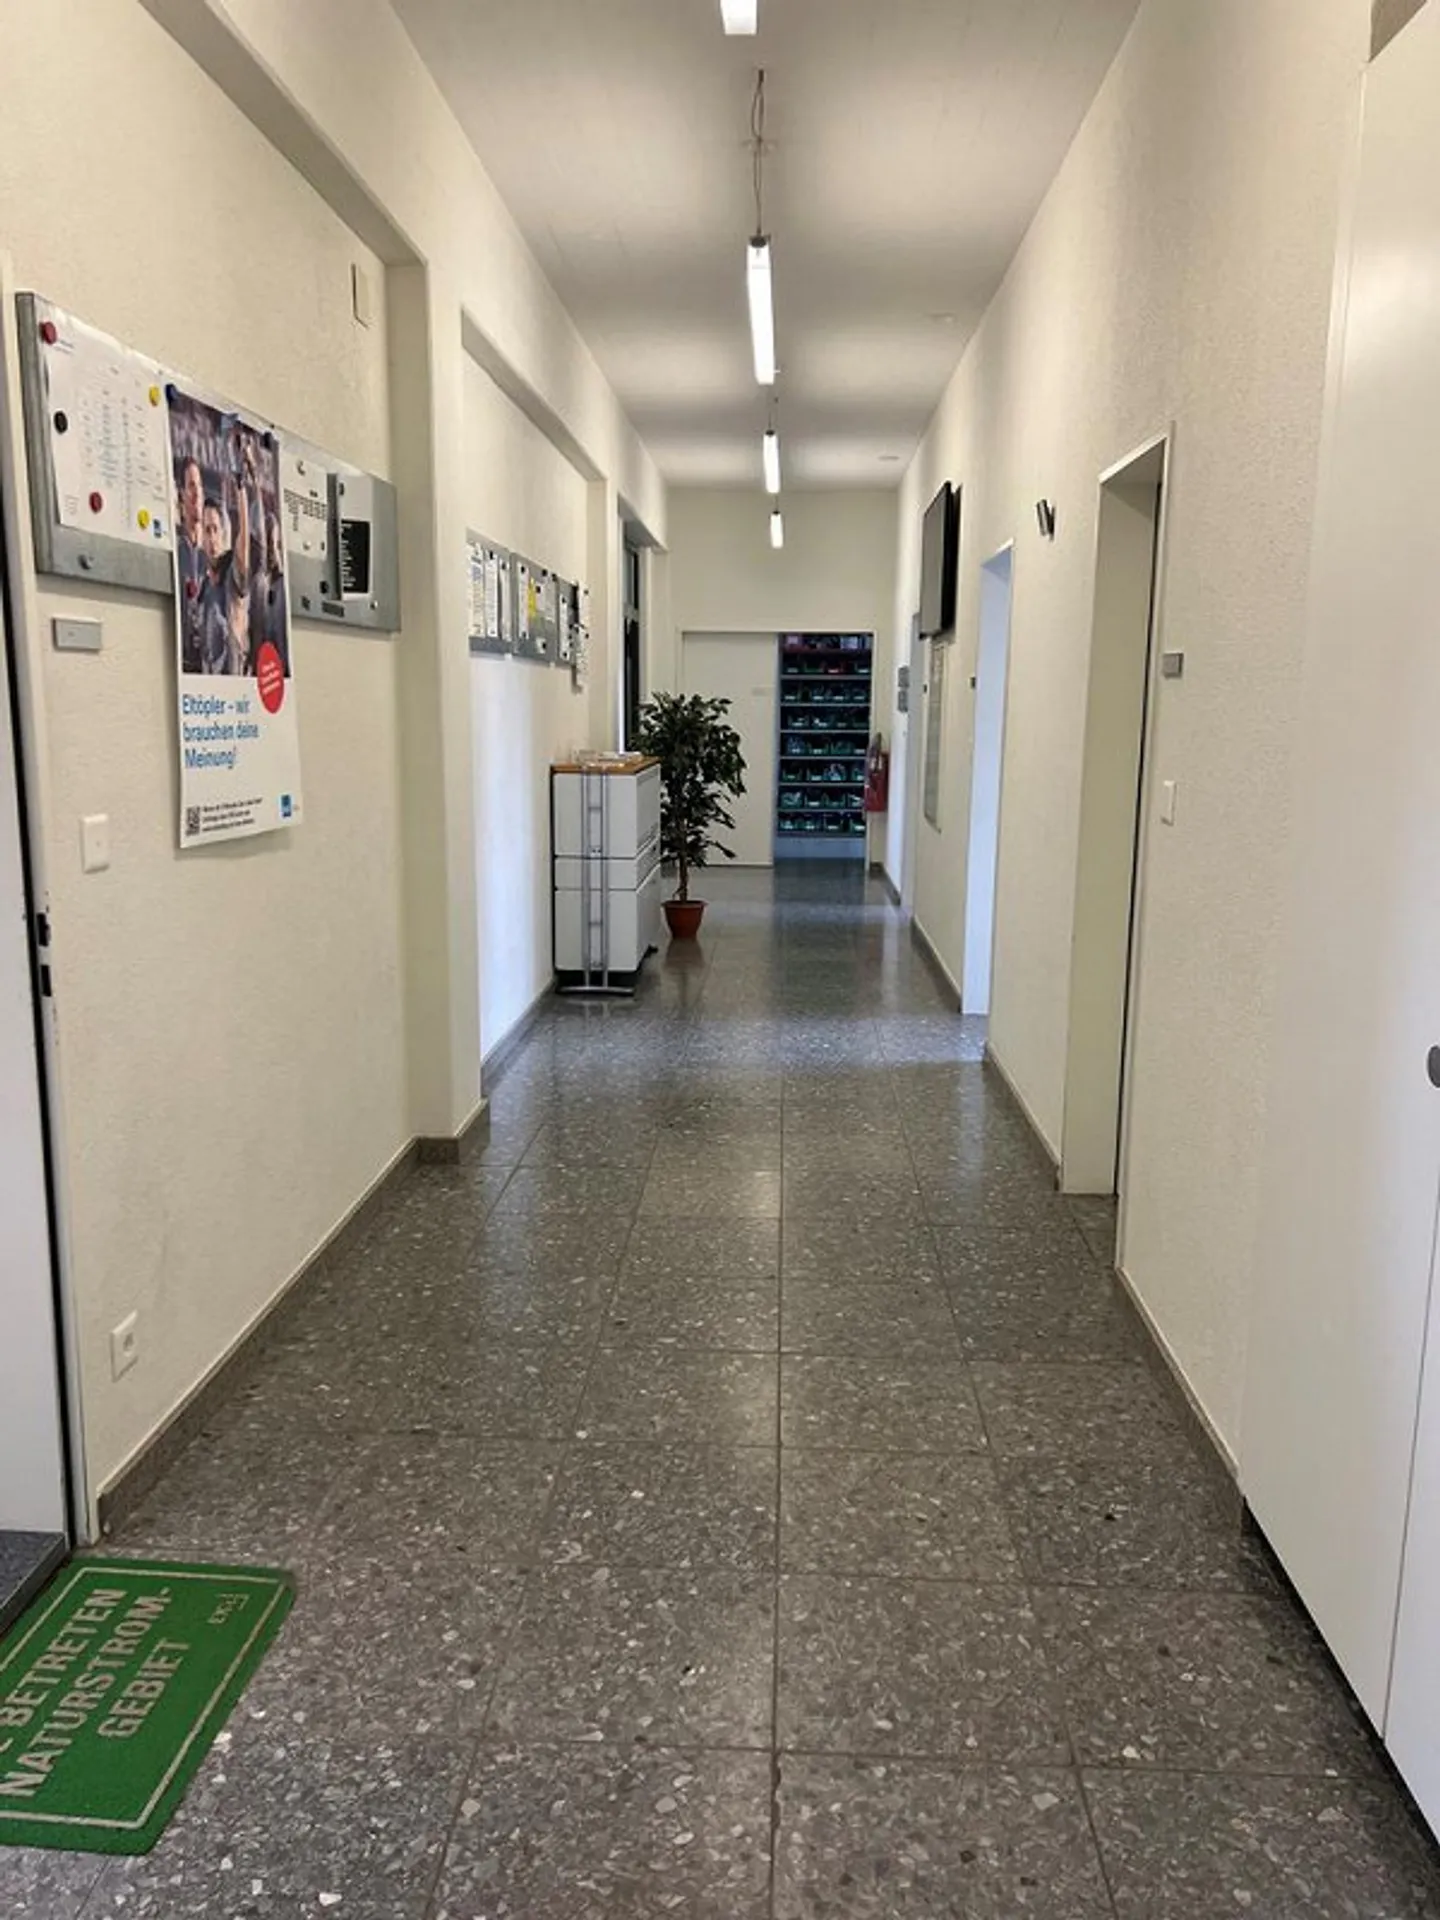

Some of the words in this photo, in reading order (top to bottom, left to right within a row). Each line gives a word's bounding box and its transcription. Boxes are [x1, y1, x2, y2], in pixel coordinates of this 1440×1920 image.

[235, 694, 251, 714] wir
[182, 721, 234, 741] brauchen
[236, 721, 259, 738] deine
[184, 746, 237, 770] Meinung!
[0, 1588, 127, 1727] BETRETEN
[97, 1639, 190, 1737] GEBIET
